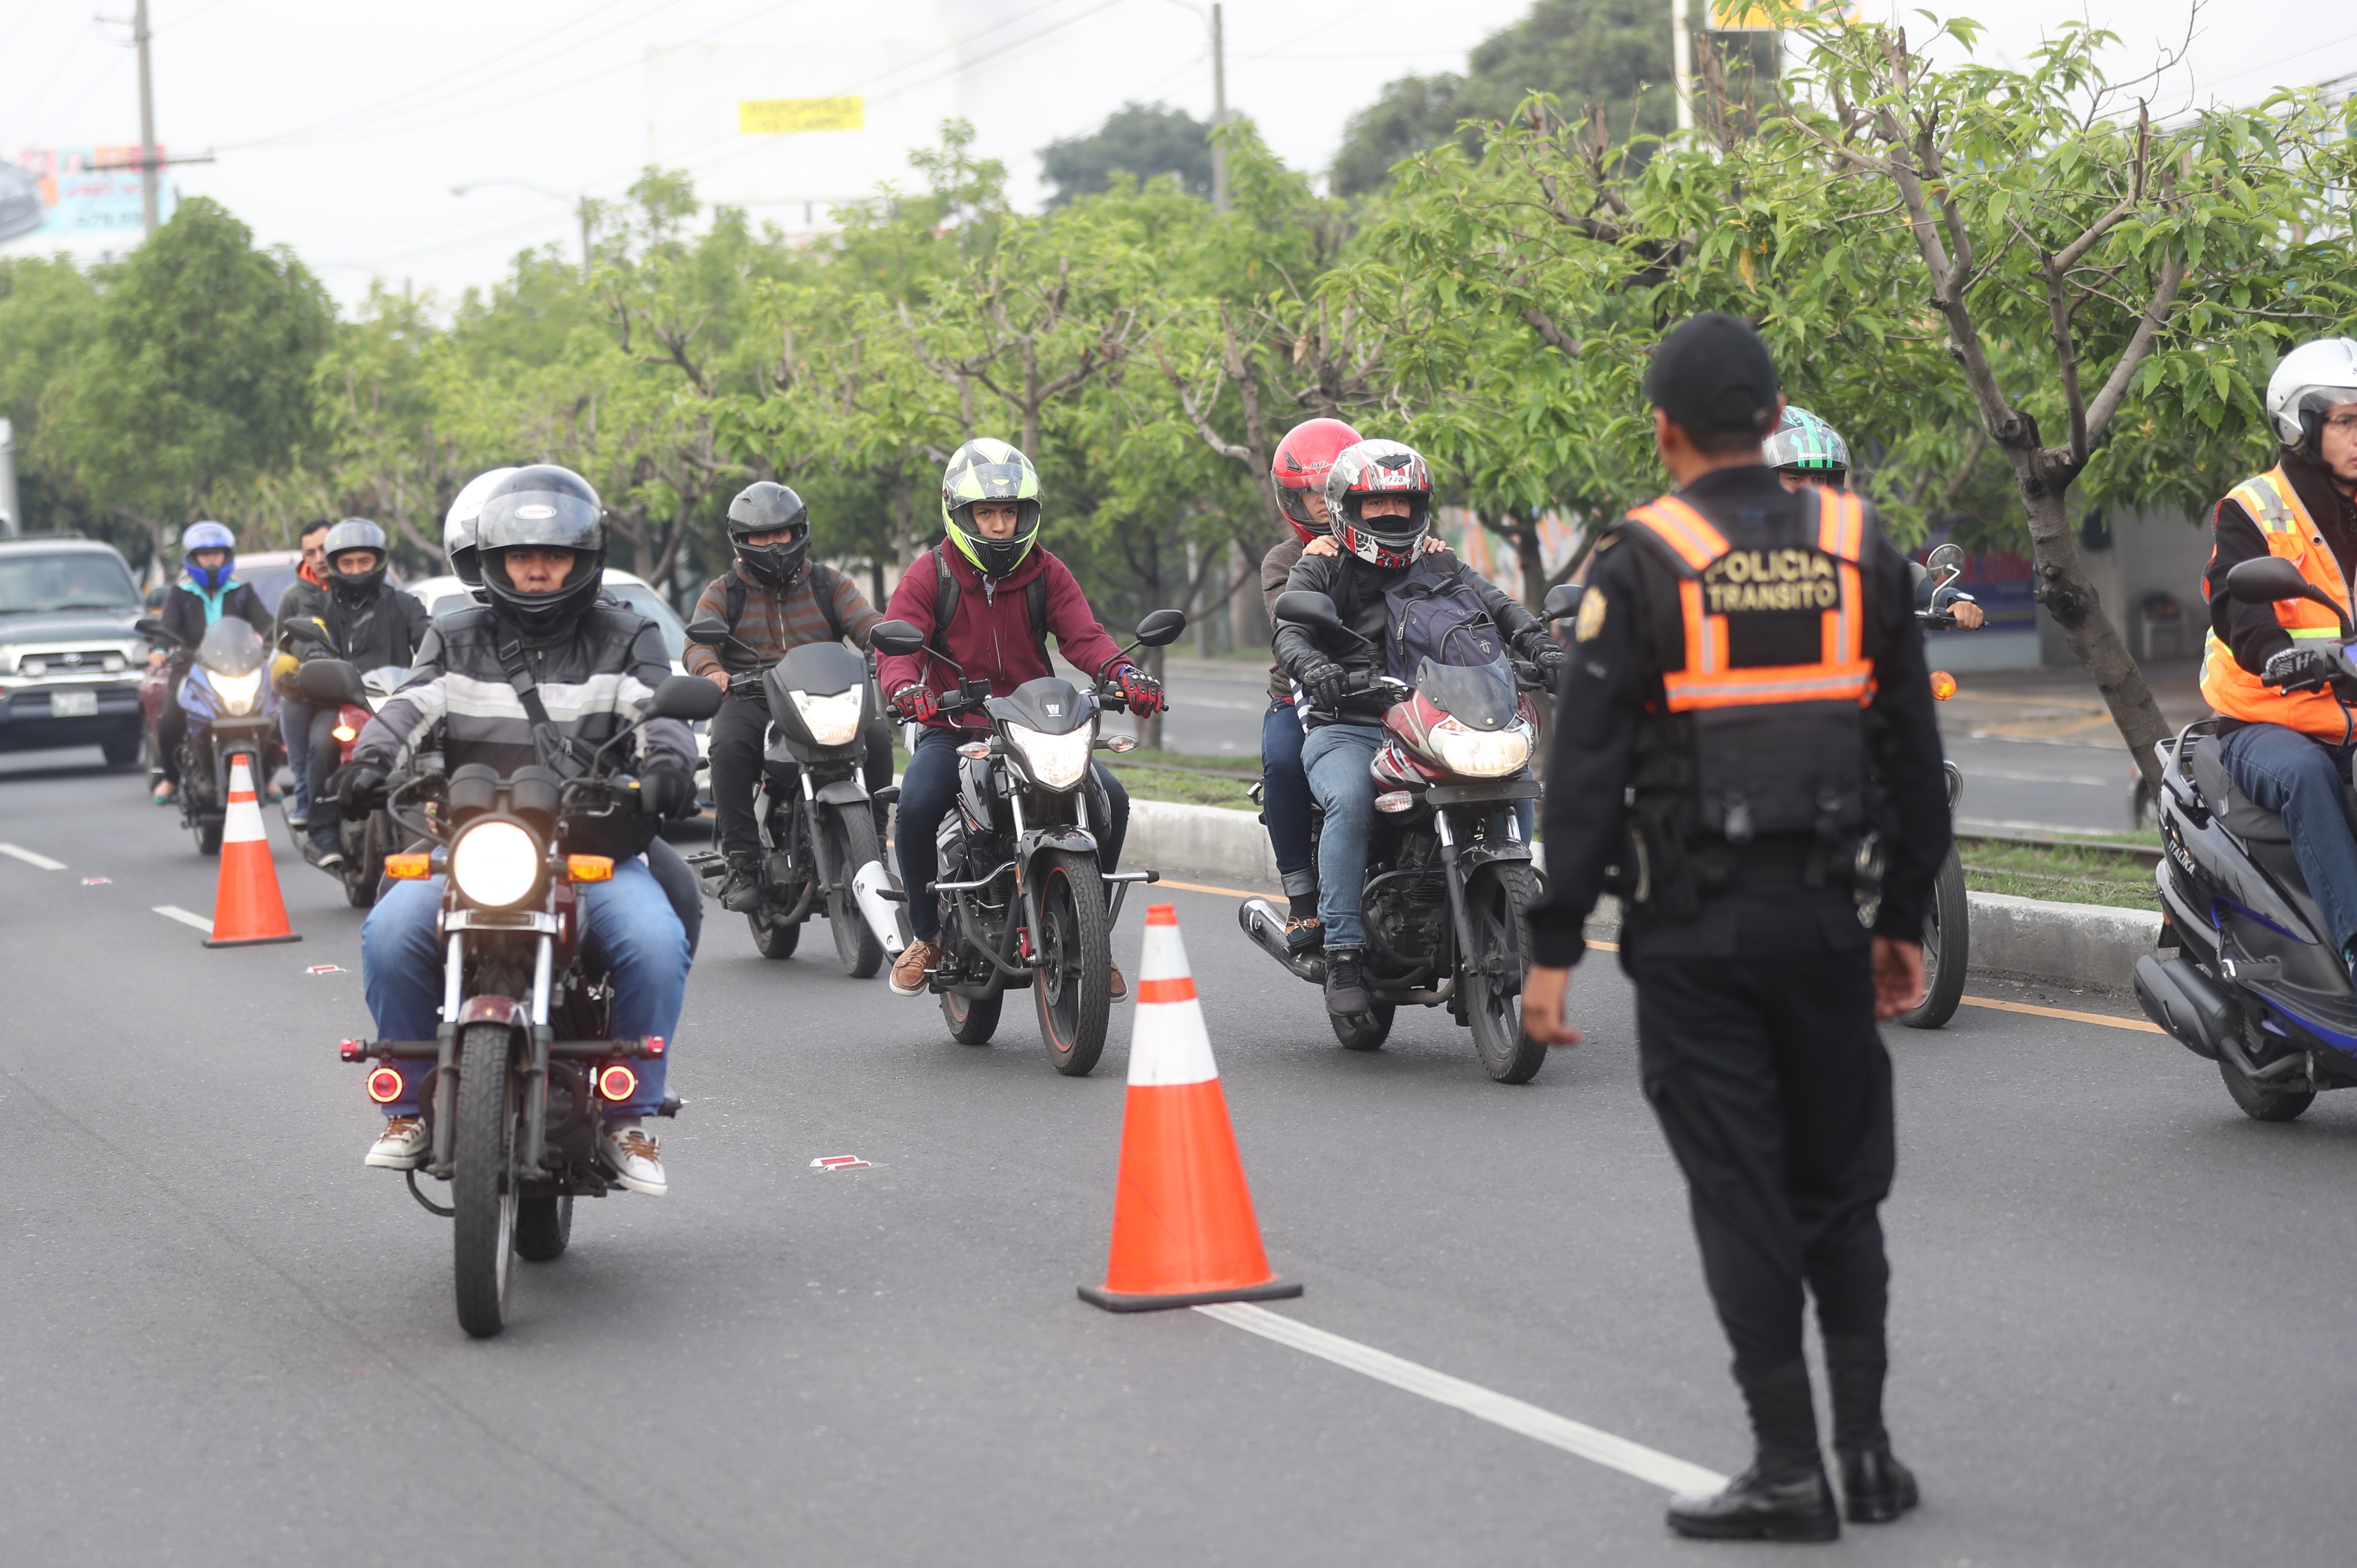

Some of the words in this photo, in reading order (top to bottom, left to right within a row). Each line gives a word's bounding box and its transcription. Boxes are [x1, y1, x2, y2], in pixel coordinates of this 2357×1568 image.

[1704, 548, 1834, 584] POLICIA
[1706, 579, 1837, 612] TRANSITO
[2169, 839, 2195, 875] ITALIKA
